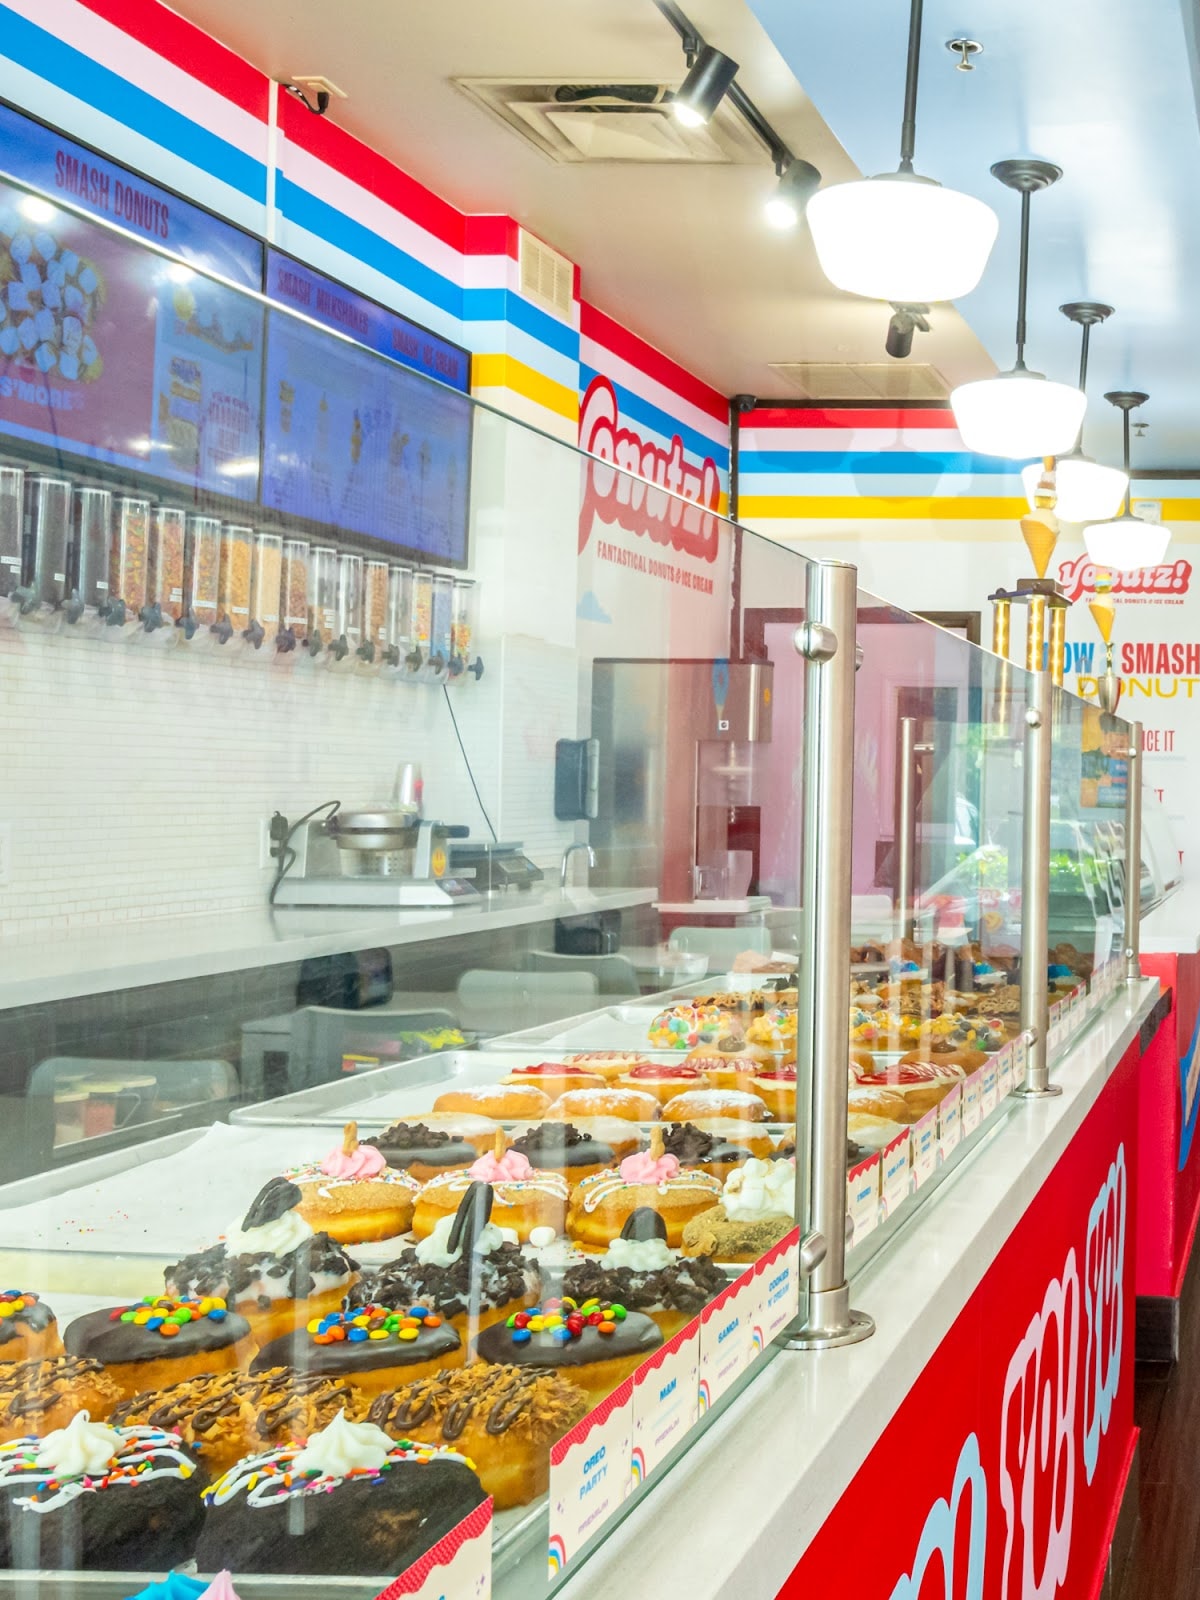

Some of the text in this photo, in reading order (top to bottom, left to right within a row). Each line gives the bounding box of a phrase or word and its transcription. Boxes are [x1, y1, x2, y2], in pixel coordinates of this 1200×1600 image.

[55, 150, 169, 239] SMASH DONUTS
[597, 540, 647, 573] FANTASTICAL
[648, 558, 675, 582] DONUTS
[681, 569, 692, 588] ICE
[693, 573, 713, 595] CREAM
[1121, 642, 1200, 675] SMASH
[1164, 730, 1175, 752] IT
[1083, 1142, 1127, 1487] YO!
[583, 1445, 606, 1475] OREO
[579, 1463, 608, 1500] PARTY
[577, 1499, 608, 1534] PREMIUM
